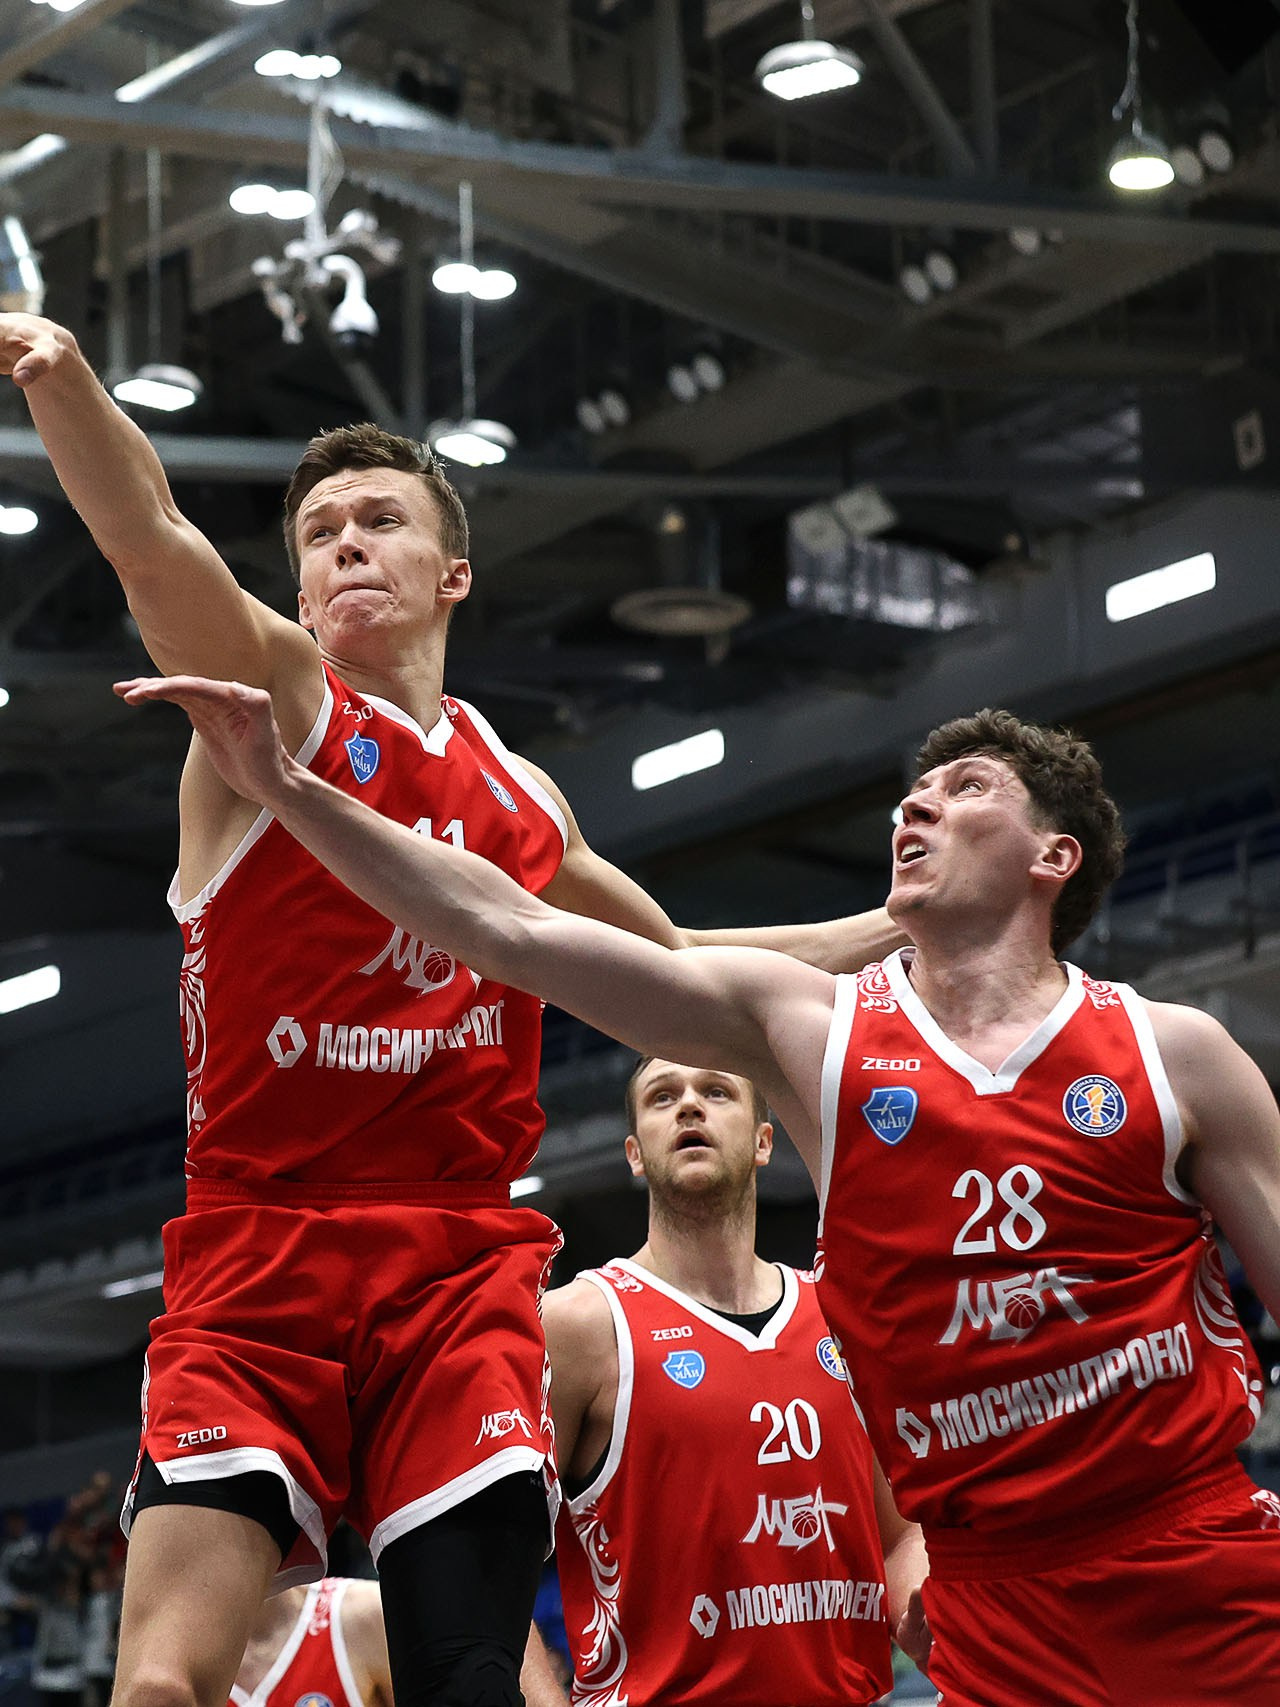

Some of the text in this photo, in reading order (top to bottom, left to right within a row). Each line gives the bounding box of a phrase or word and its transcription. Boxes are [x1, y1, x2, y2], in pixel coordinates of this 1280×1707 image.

[861, 1057, 921, 1072] ZEDO
[876, 1108, 907, 1130] МАИ
[951, 1164, 1047, 1256] 28
[650, 1325, 694, 1341] ZEDO
[929, 1322, 1194, 1451] МОСИНЖПРОЕКТ
[176, 1425, 227, 1449] ZEDO
[749, 1398, 822, 1465] 20
